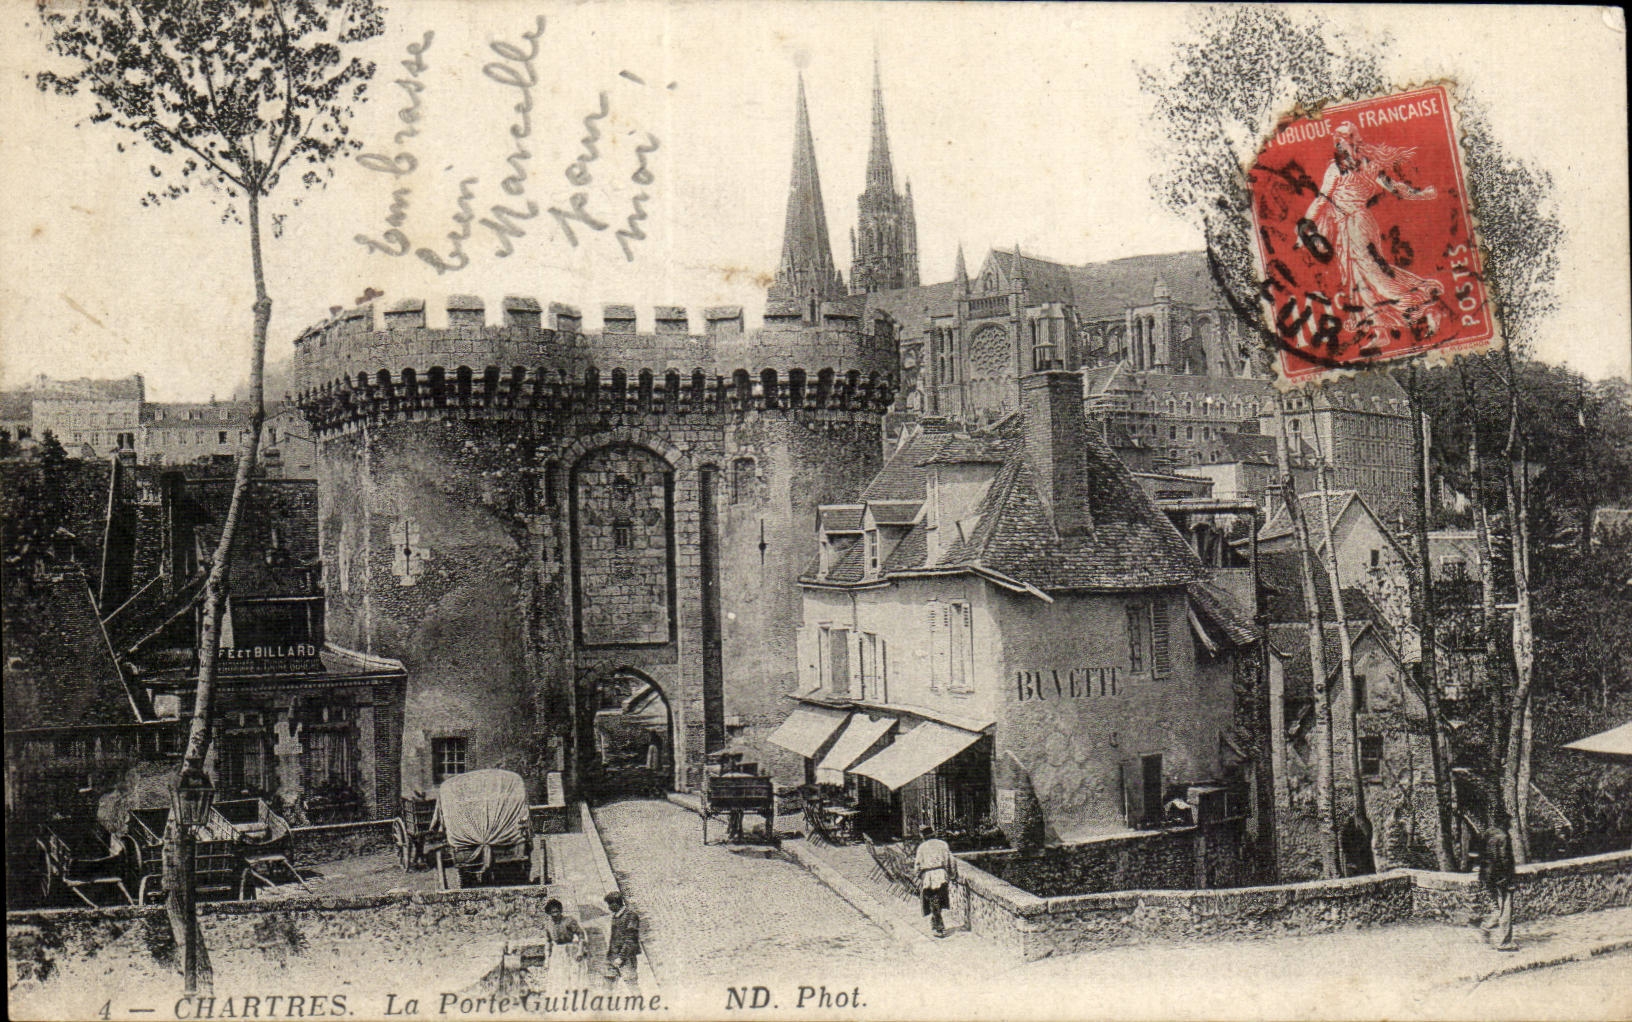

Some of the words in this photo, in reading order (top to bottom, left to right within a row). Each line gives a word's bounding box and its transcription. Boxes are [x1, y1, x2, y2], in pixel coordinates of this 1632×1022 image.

[1357, 97, 1440, 129] FRANÇAISE
[479, 14, 547, 258] Marcelle
[1447, 243, 1481, 328] POSTES
[254, 645, 315, 658] BILLARD
[1017, 666, 1123, 701] BUVETTE
